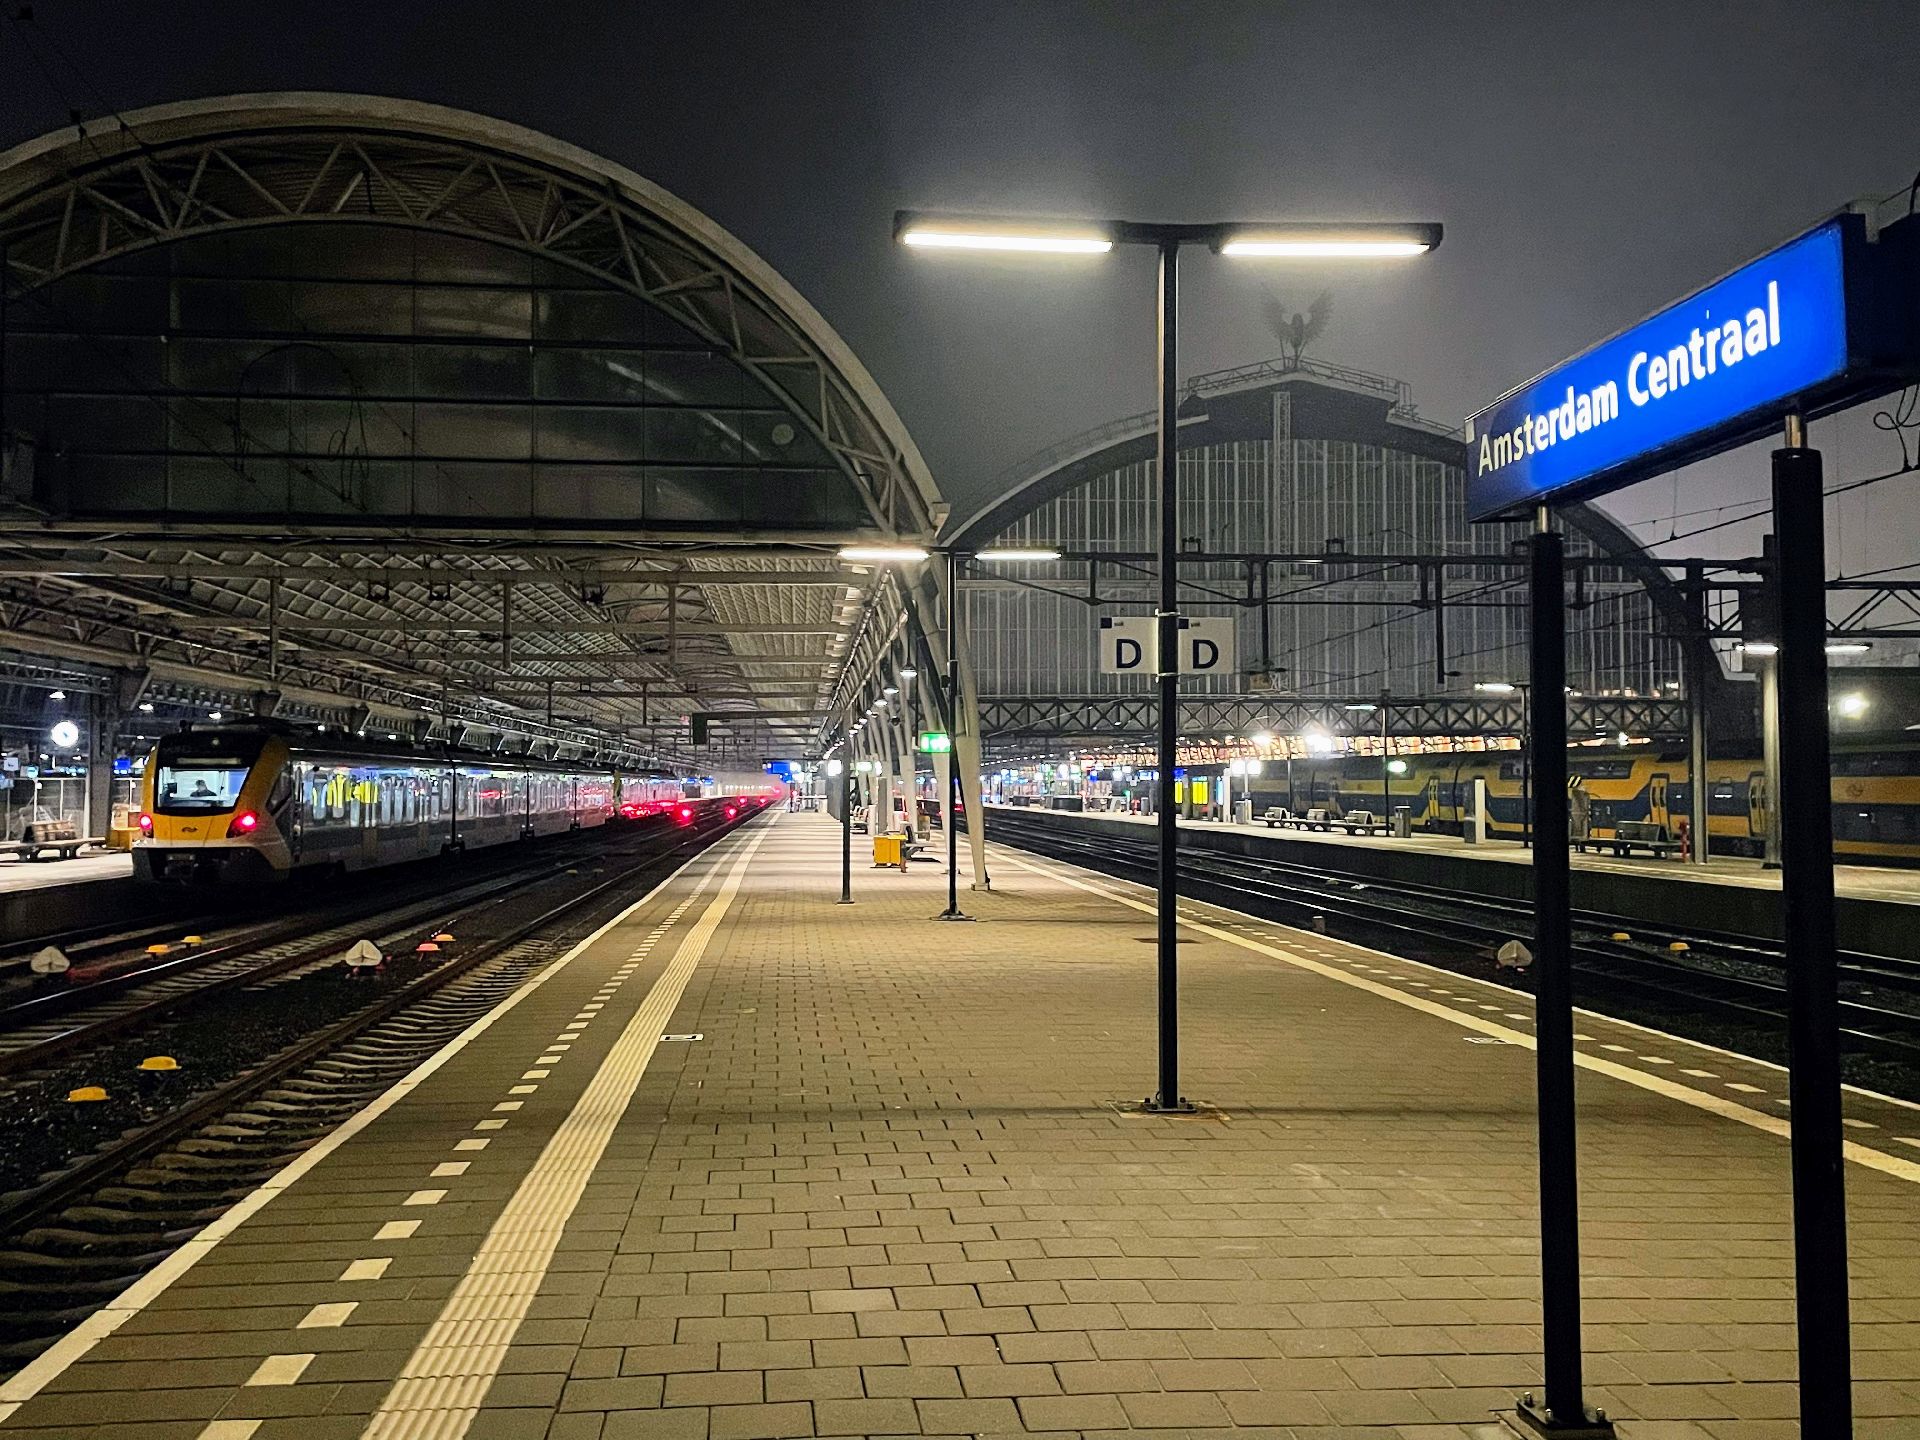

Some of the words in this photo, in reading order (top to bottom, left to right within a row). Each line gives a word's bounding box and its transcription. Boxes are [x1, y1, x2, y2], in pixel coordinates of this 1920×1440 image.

[1478, 379, 1619, 477] Amsterdam
[1627, 281, 1781, 407] Centraal
[1116, 639, 1142, 668] D
[1193, 639, 1219, 669] D
